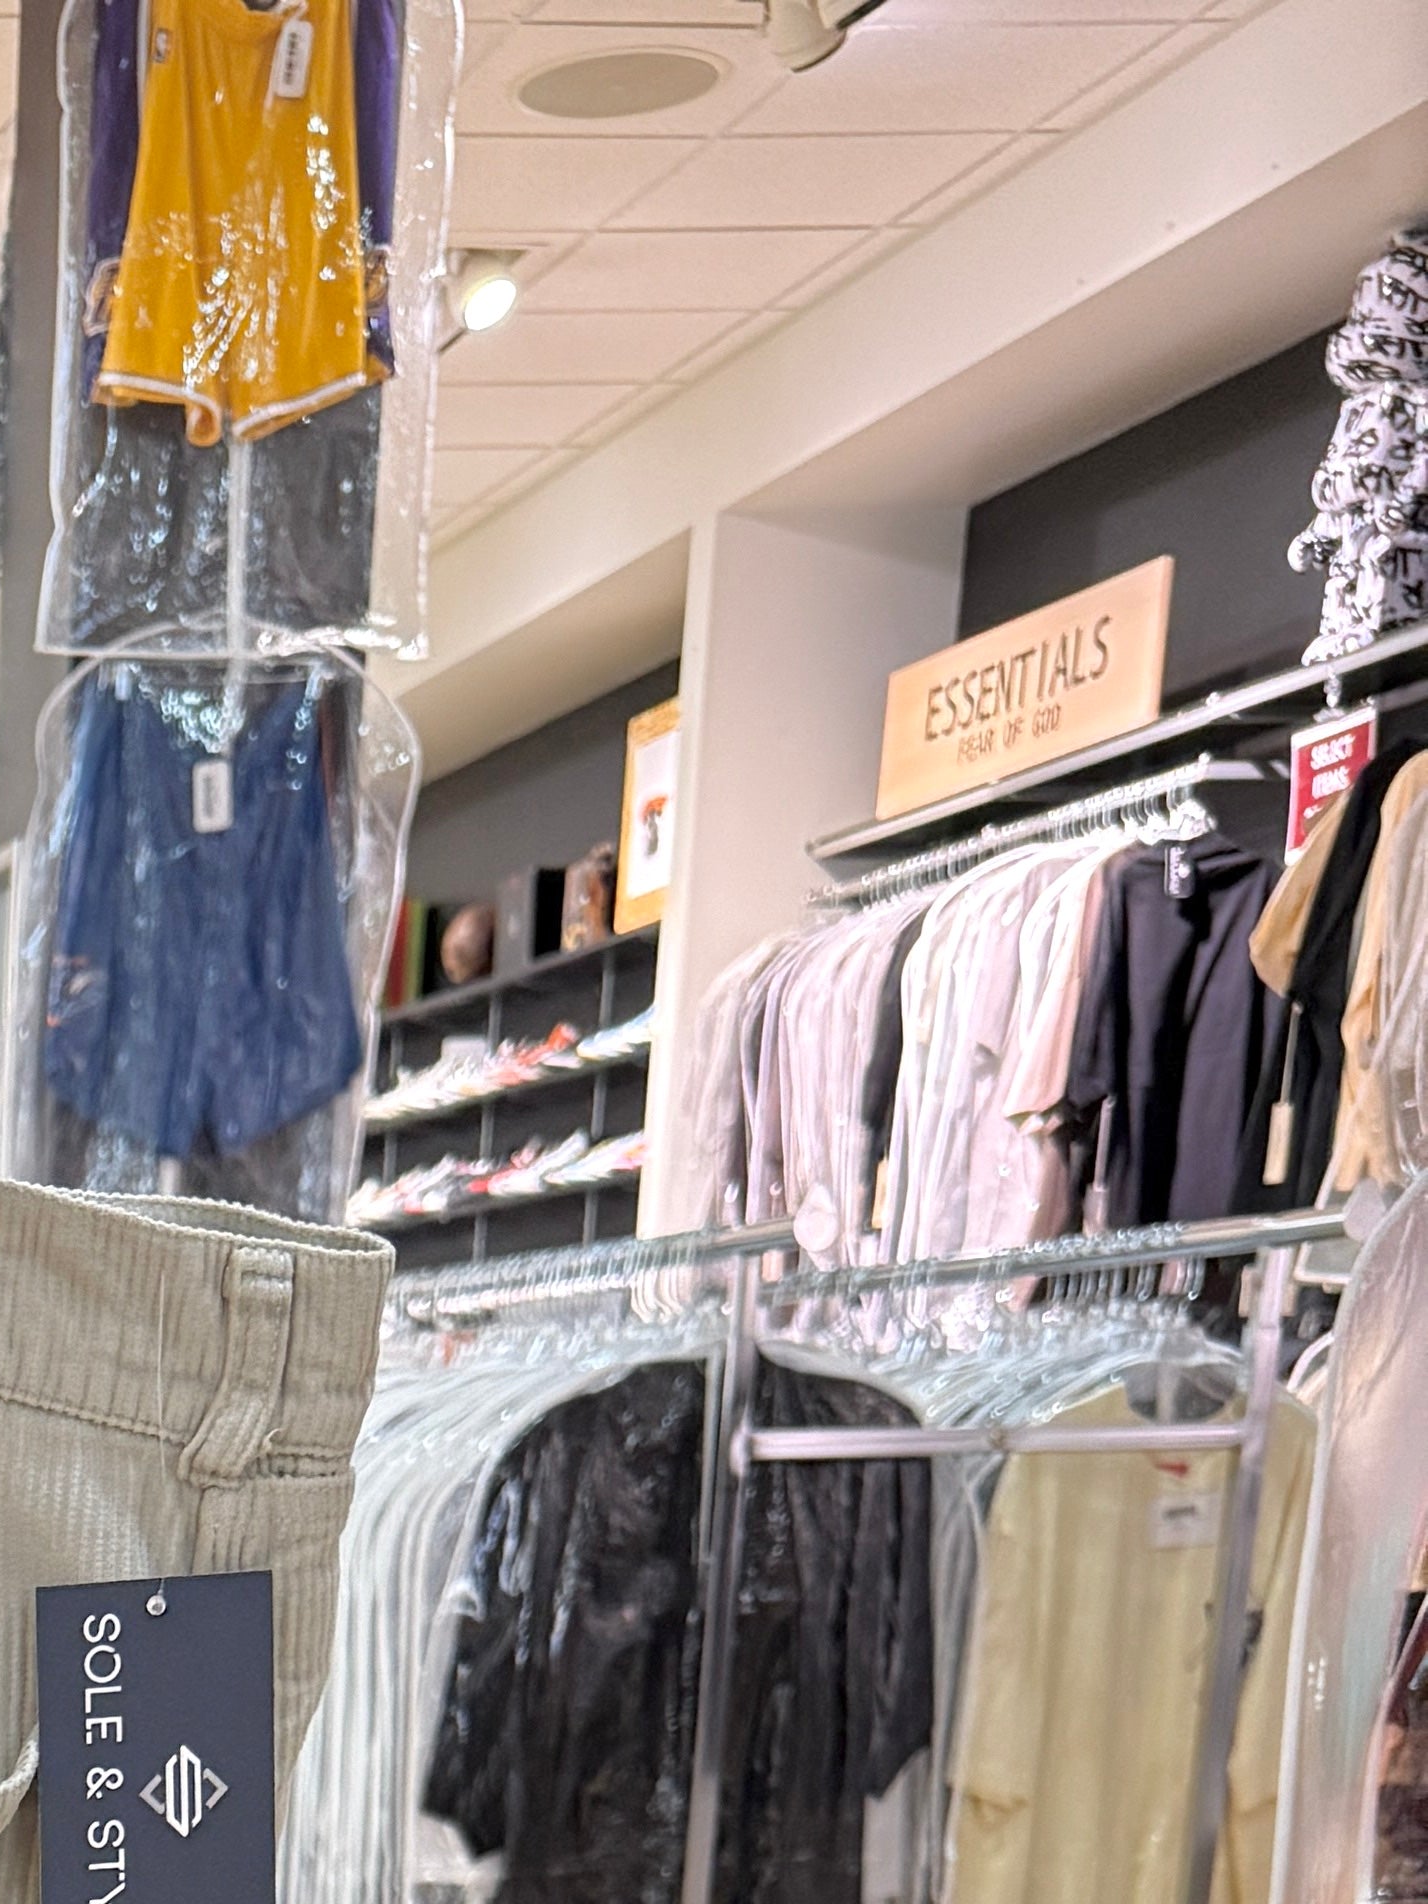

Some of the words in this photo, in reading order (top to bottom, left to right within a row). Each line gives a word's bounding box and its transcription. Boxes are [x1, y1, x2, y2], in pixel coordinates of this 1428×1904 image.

[924, 613, 1112, 742] ESSENTIALS
[82, 1612, 123, 1745] SOLE
[86, 1766, 124, 1800] &
